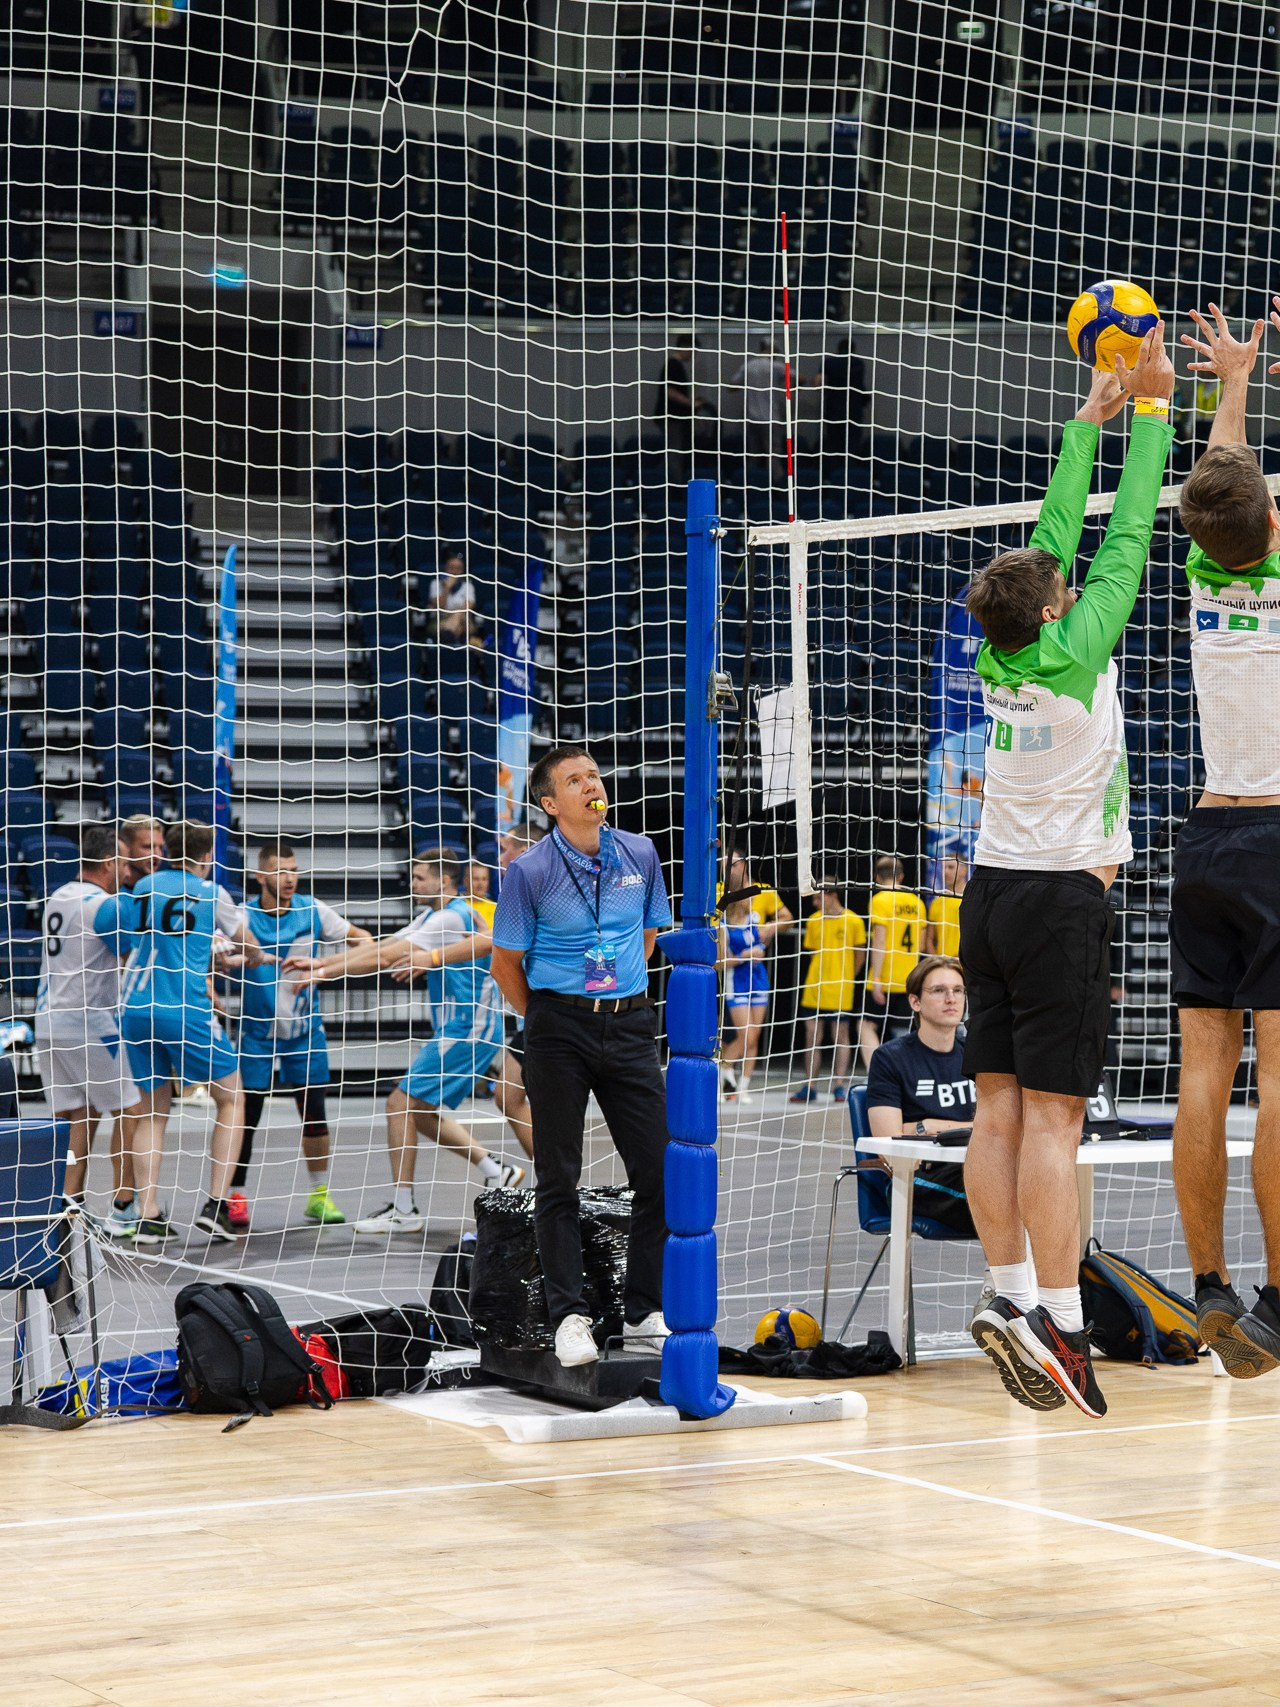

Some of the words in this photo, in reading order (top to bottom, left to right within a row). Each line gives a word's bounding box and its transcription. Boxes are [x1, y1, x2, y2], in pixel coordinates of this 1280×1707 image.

[986, 693, 1009, 711] ЕДИНЫЙ
[1009, 702, 1036, 713] ЦУПИС
[133, 893, 200, 938] 16
[46, 911, 63, 957] 8
[901, 923, 914, 954] 4
[1088, 1084, 1111, 1119] 5
